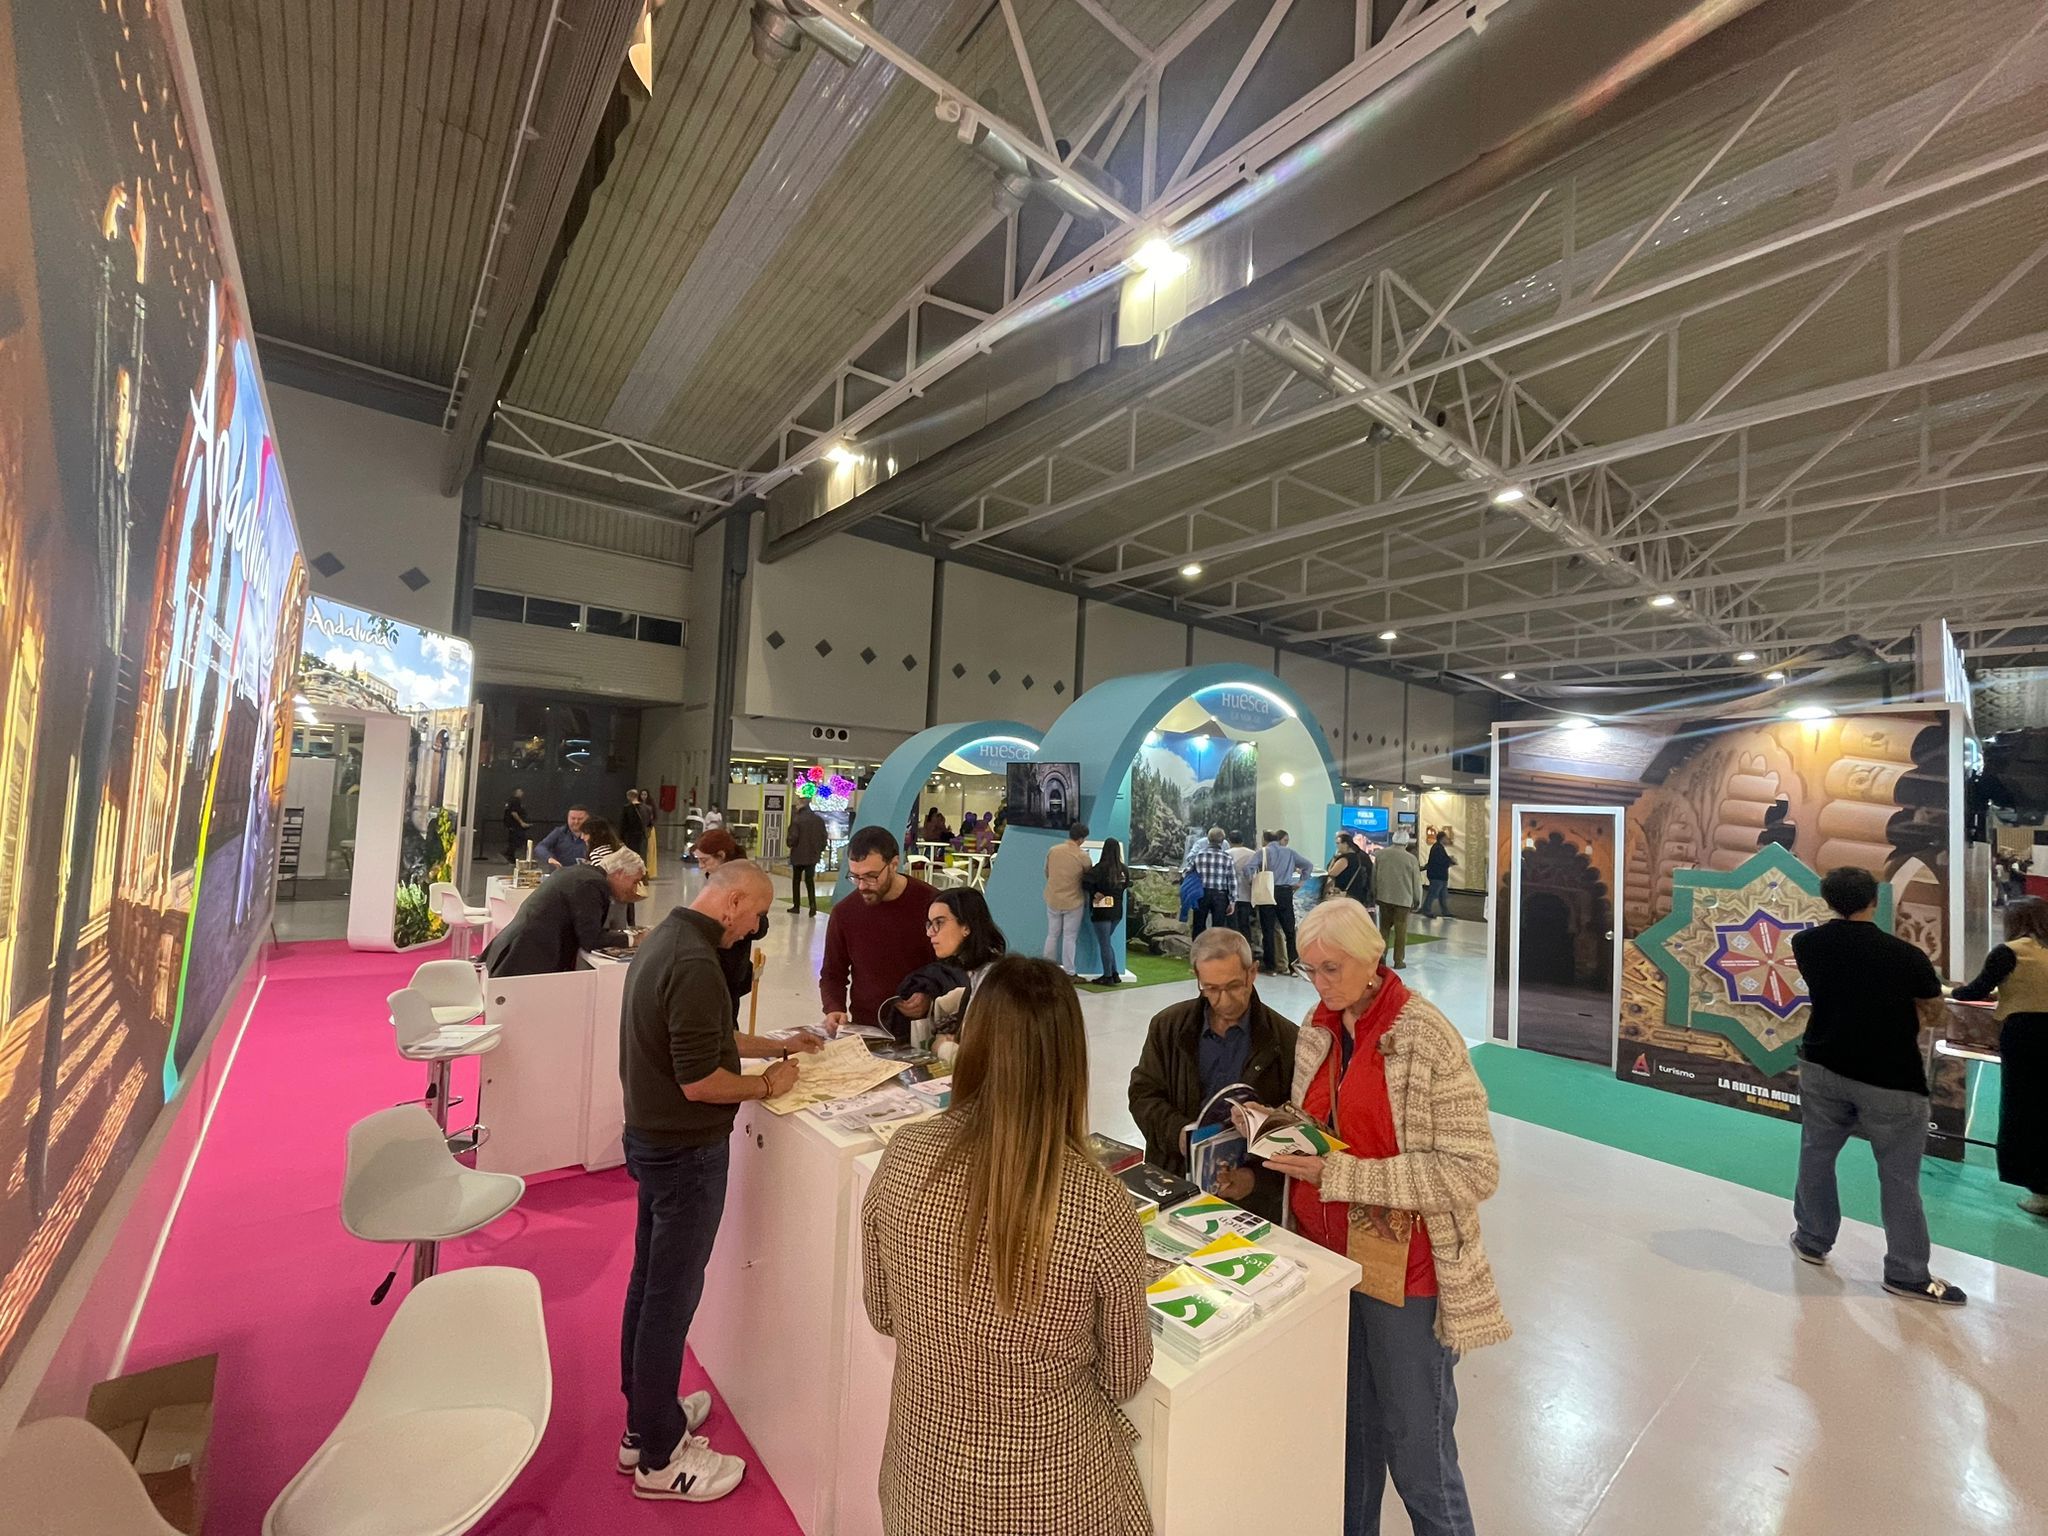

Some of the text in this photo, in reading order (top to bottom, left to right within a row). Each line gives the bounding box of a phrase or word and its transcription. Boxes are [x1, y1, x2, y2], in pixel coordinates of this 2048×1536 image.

[1658, 1064, 1696, 1079] turismo
[1718, 1077, 1731, 1090] LA
[1732, 1080, 1770, 1098] RULETA
[670, 1471, 697, 1494] N
